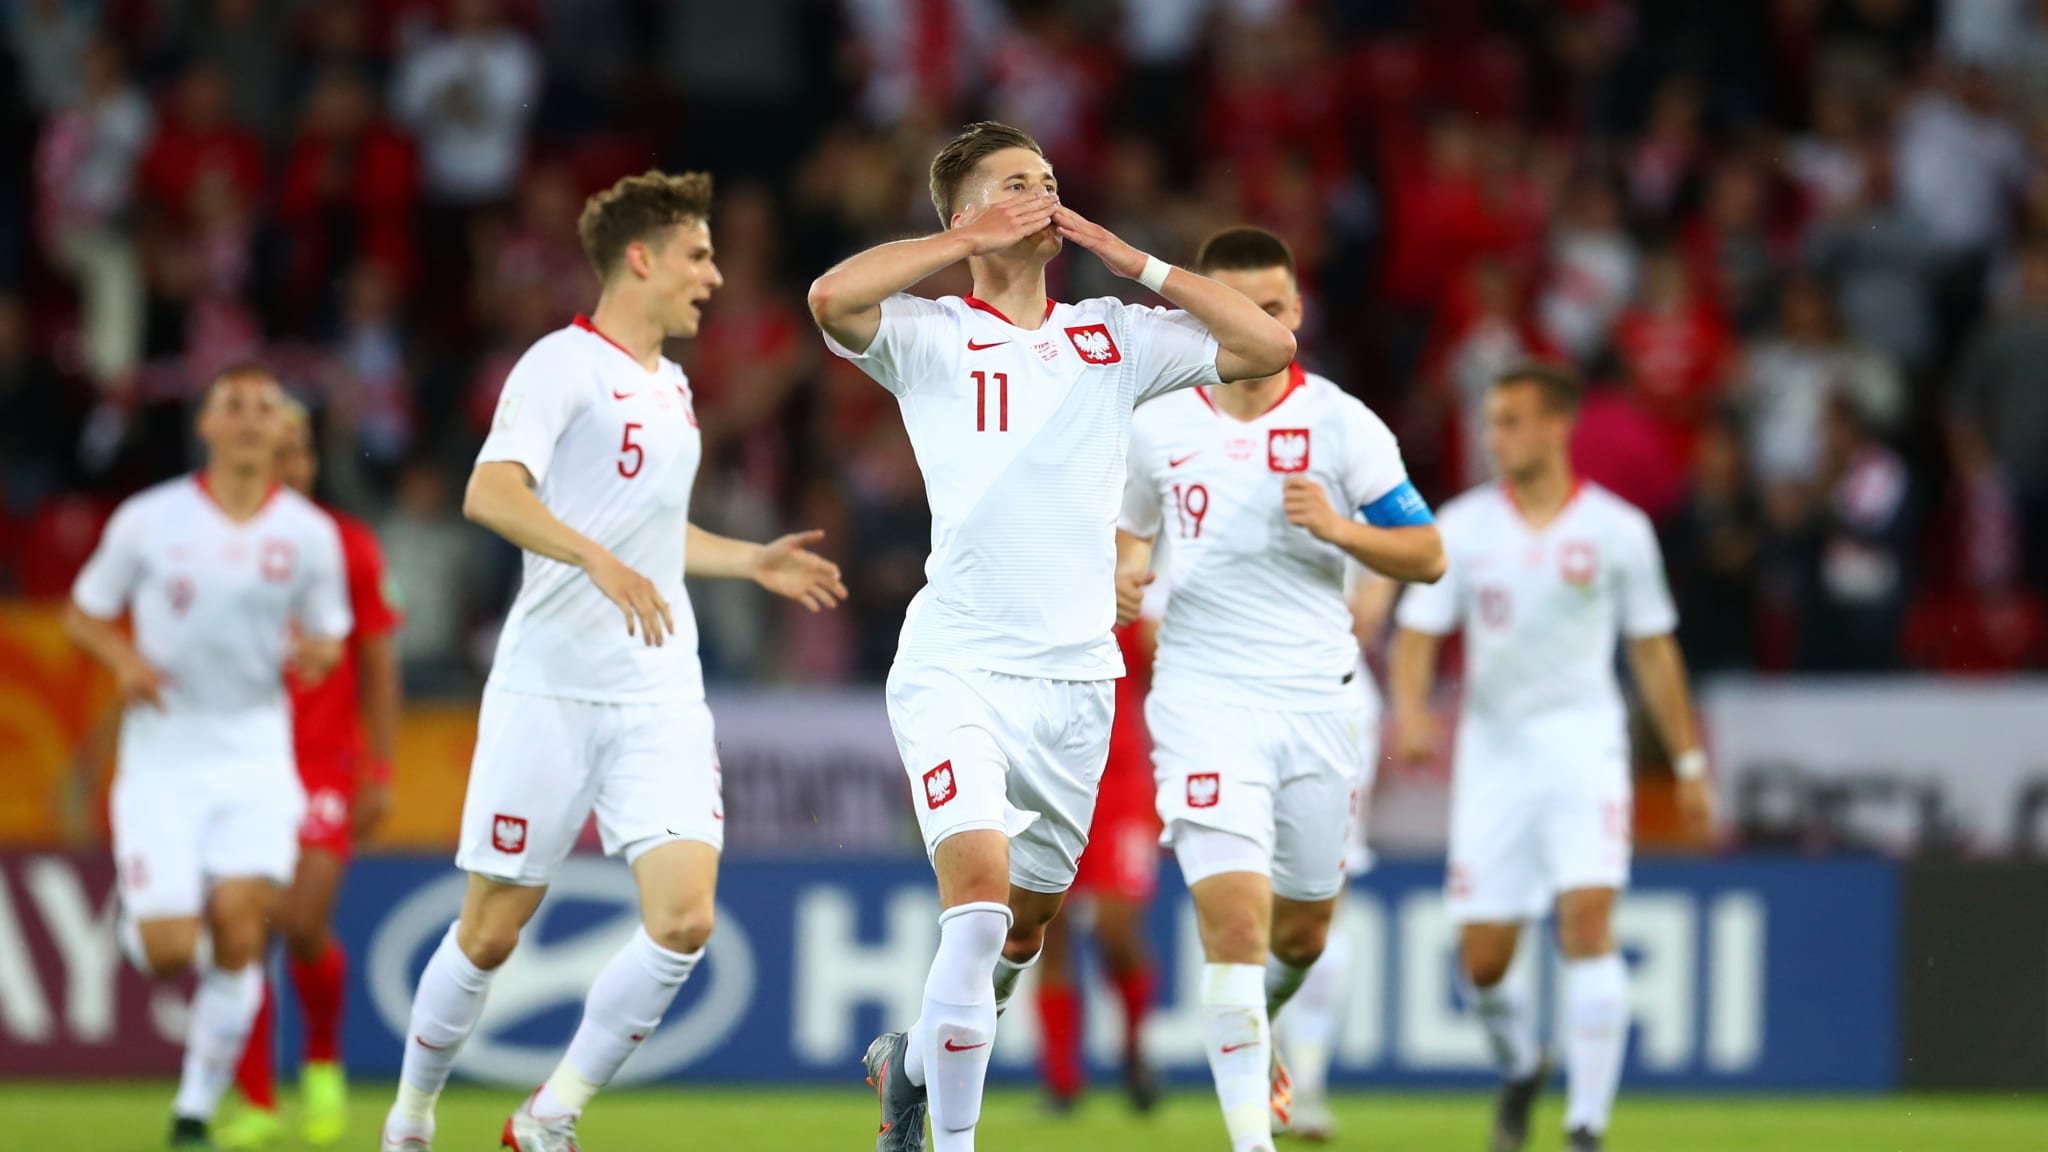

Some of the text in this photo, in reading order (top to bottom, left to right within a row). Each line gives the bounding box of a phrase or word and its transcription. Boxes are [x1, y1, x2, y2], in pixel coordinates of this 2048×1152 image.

[970, 371, 1008, 432] 11
[617, 422, 644, 480] 5
[1172, 483, 1209, 539] 19
[792, 884, 1764, 1070] HUDAI
